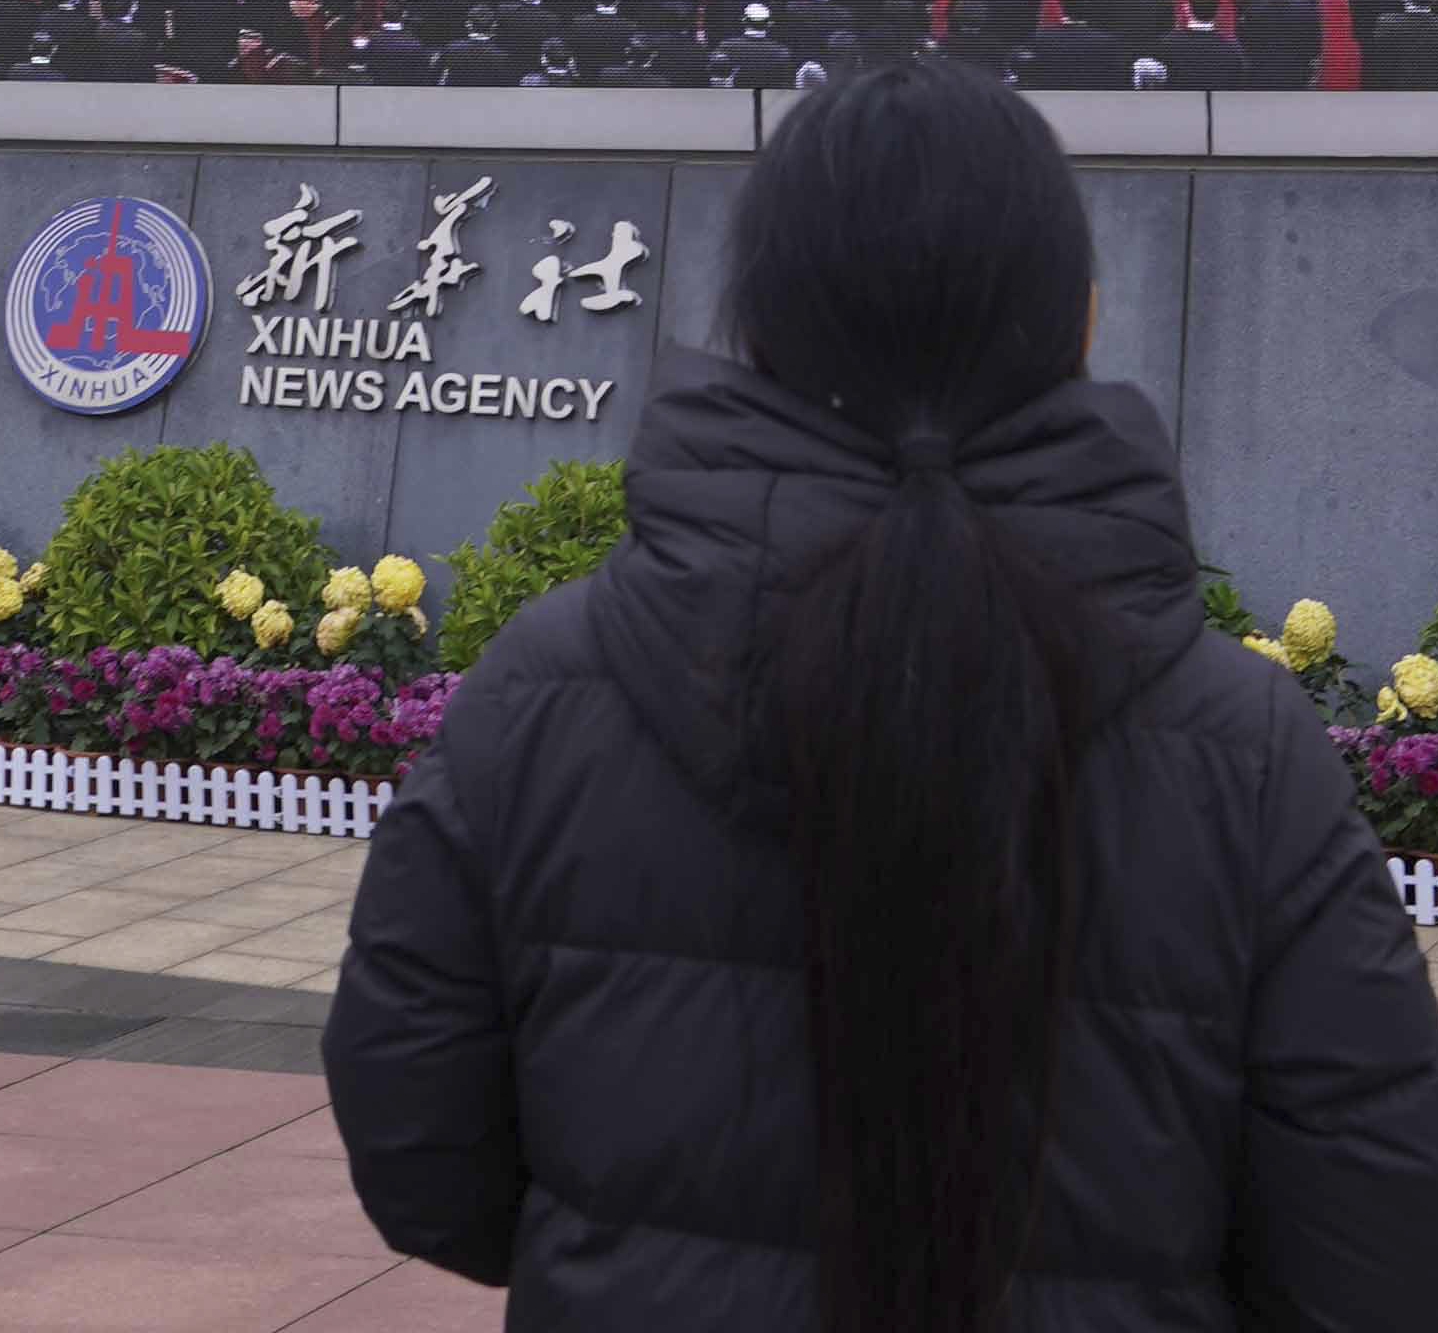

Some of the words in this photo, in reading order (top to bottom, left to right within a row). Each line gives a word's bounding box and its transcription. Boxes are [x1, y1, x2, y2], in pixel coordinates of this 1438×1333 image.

[246, 317, 431, 361] XINHUA
[38, 363, 150, 400] XINHUA
[240, 366, 382, 410] NEWS
[394, 373, 612, 420] AGENCY
